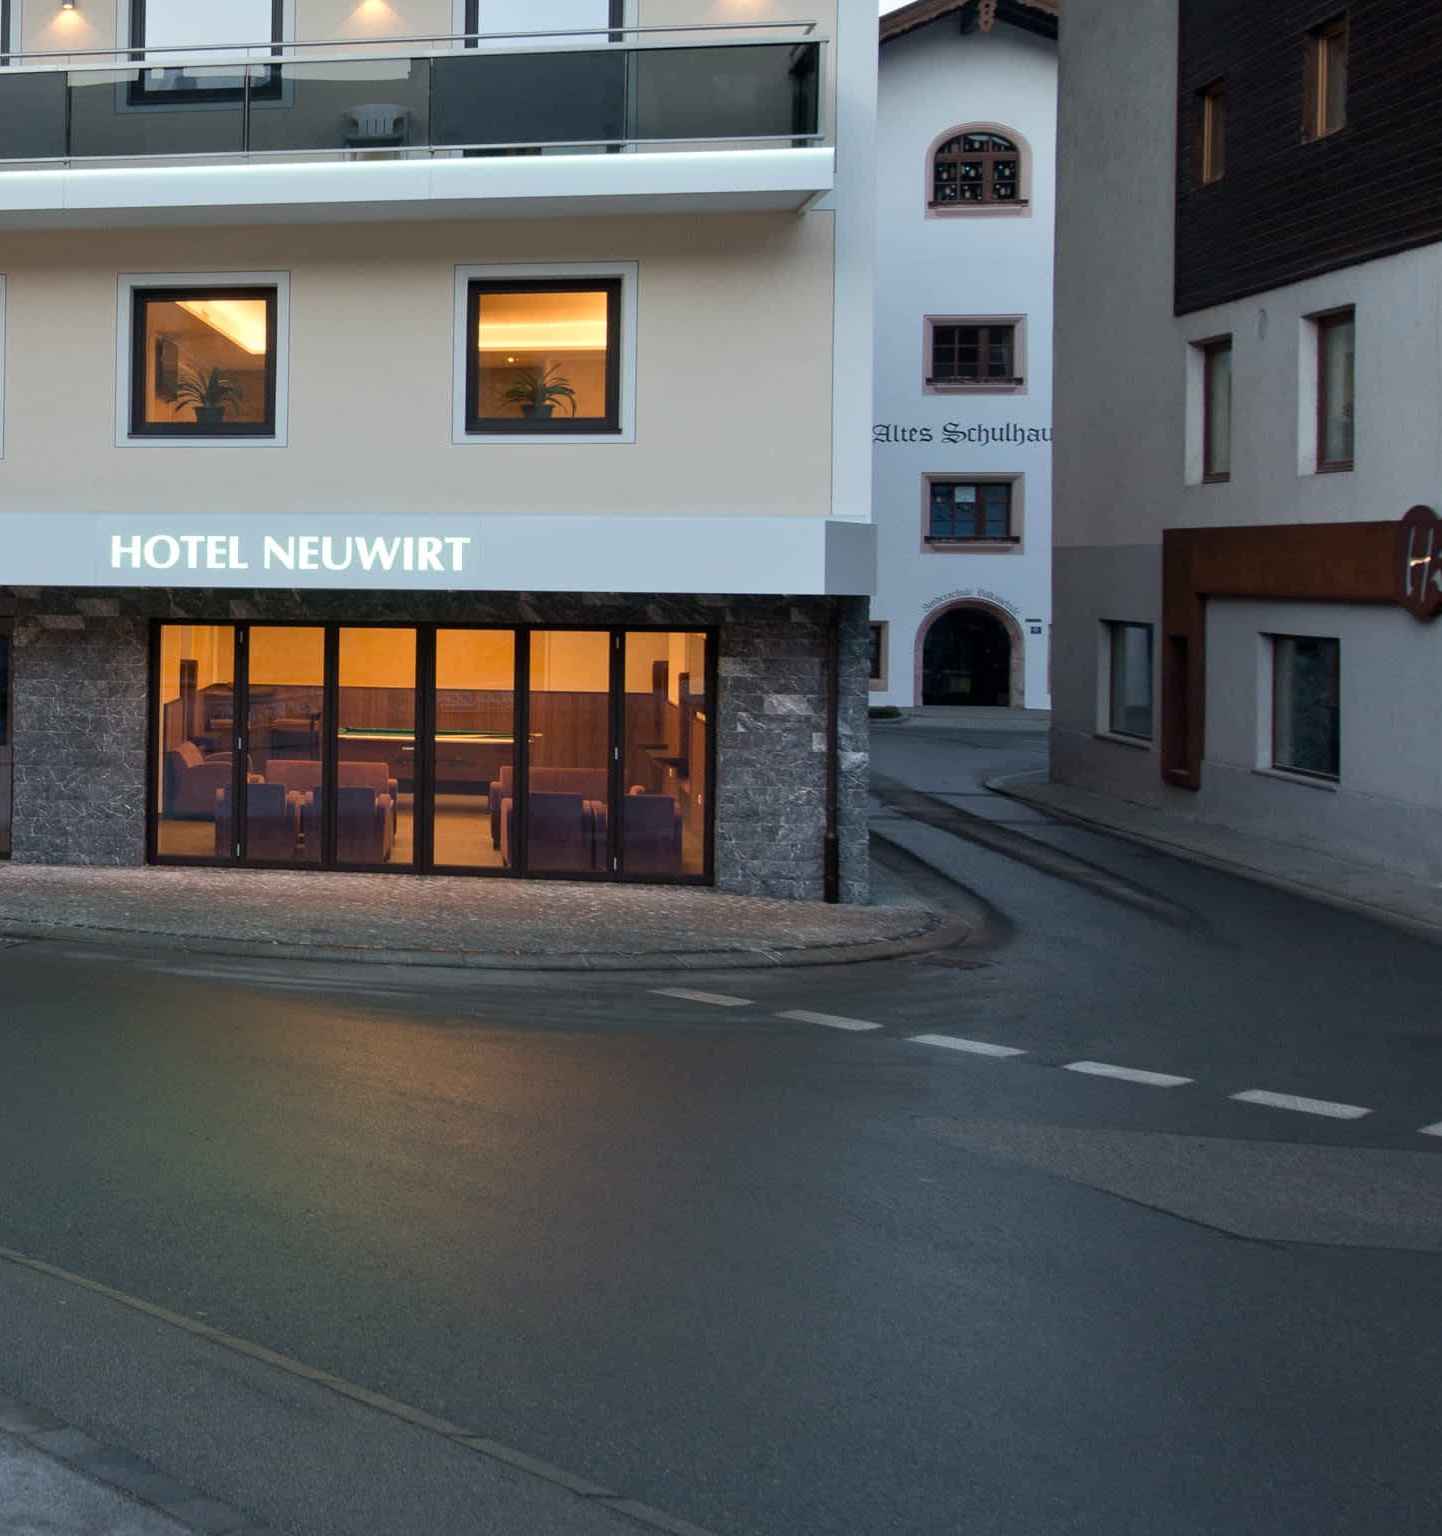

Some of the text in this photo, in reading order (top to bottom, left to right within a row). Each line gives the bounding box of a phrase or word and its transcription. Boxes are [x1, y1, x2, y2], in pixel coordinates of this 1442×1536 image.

[872, 423, 933, 444] Altes
[111, 535, 470, 571] HOTEL NEUWIRT
